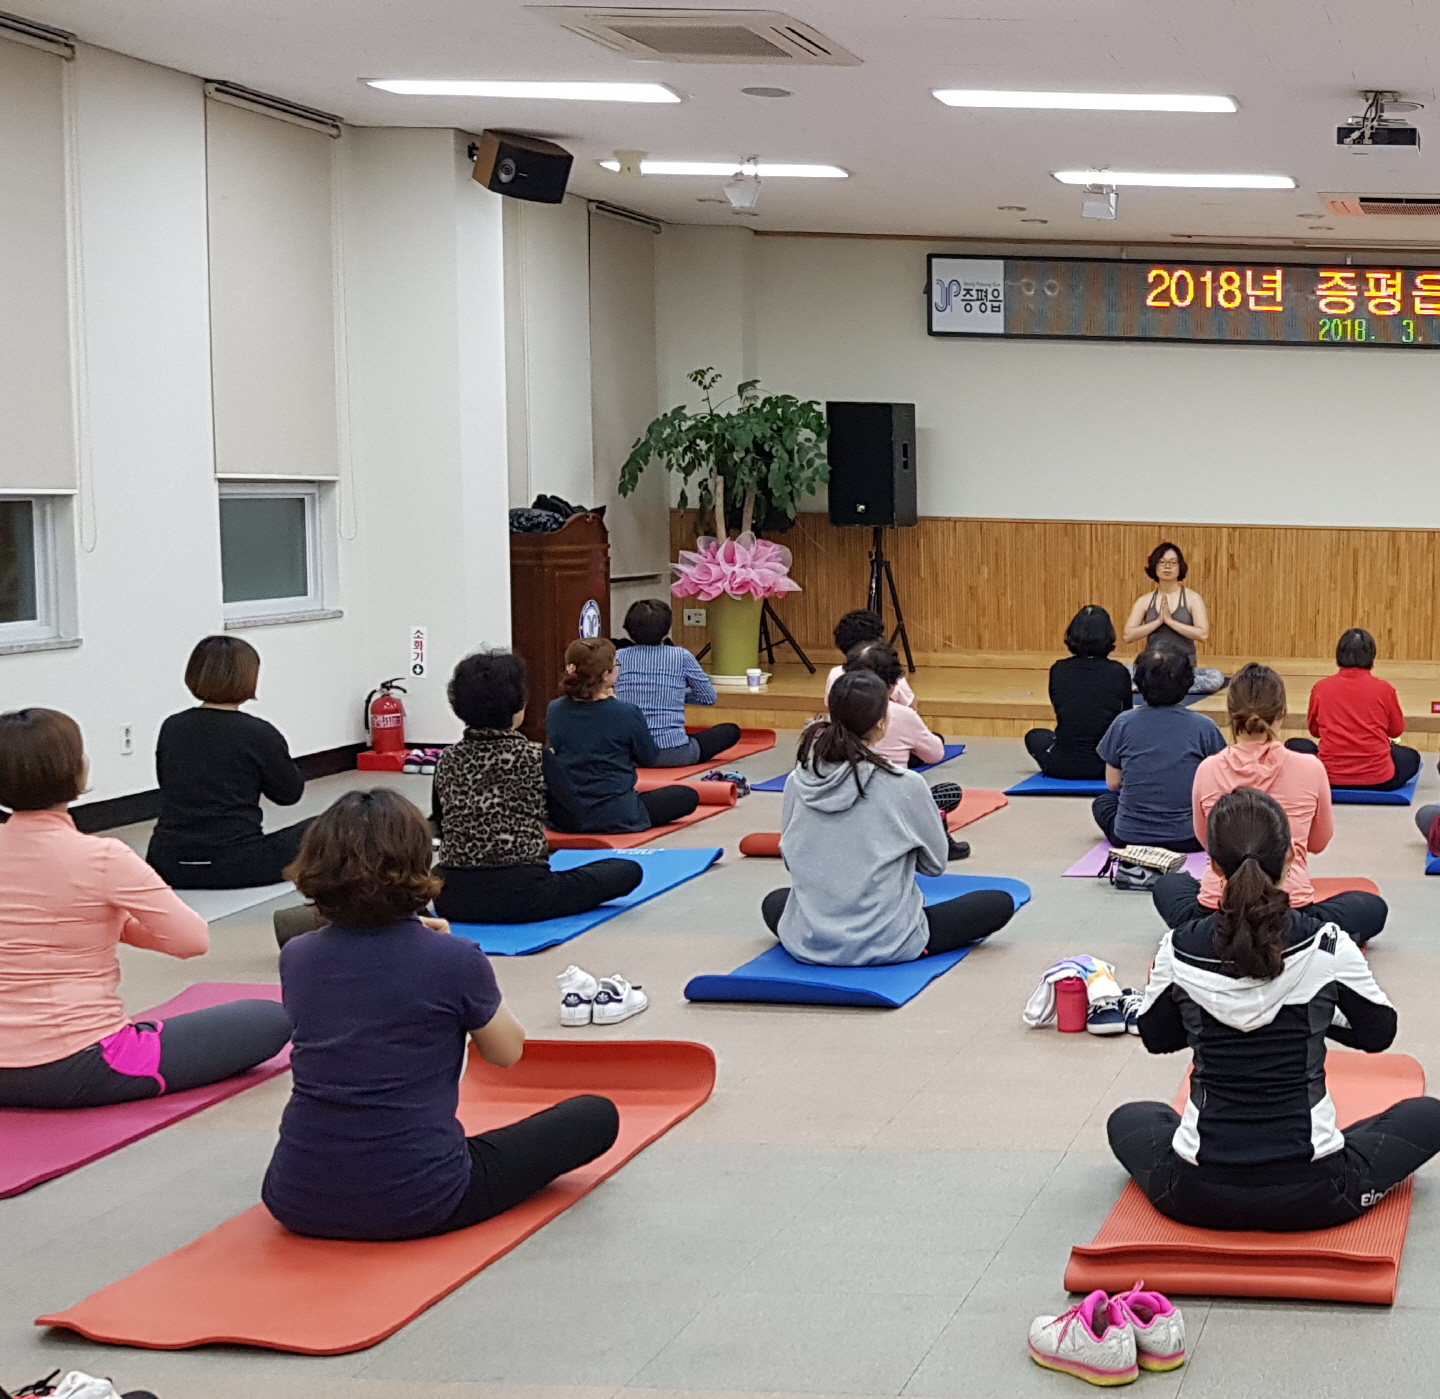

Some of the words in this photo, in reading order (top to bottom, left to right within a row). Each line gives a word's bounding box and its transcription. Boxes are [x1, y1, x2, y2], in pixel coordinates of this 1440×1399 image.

[961, 288, 1003, 314] 증평읍
[1145, 268, 1284, 313] 2018년
[413, 629, 424, 663] 소화기
